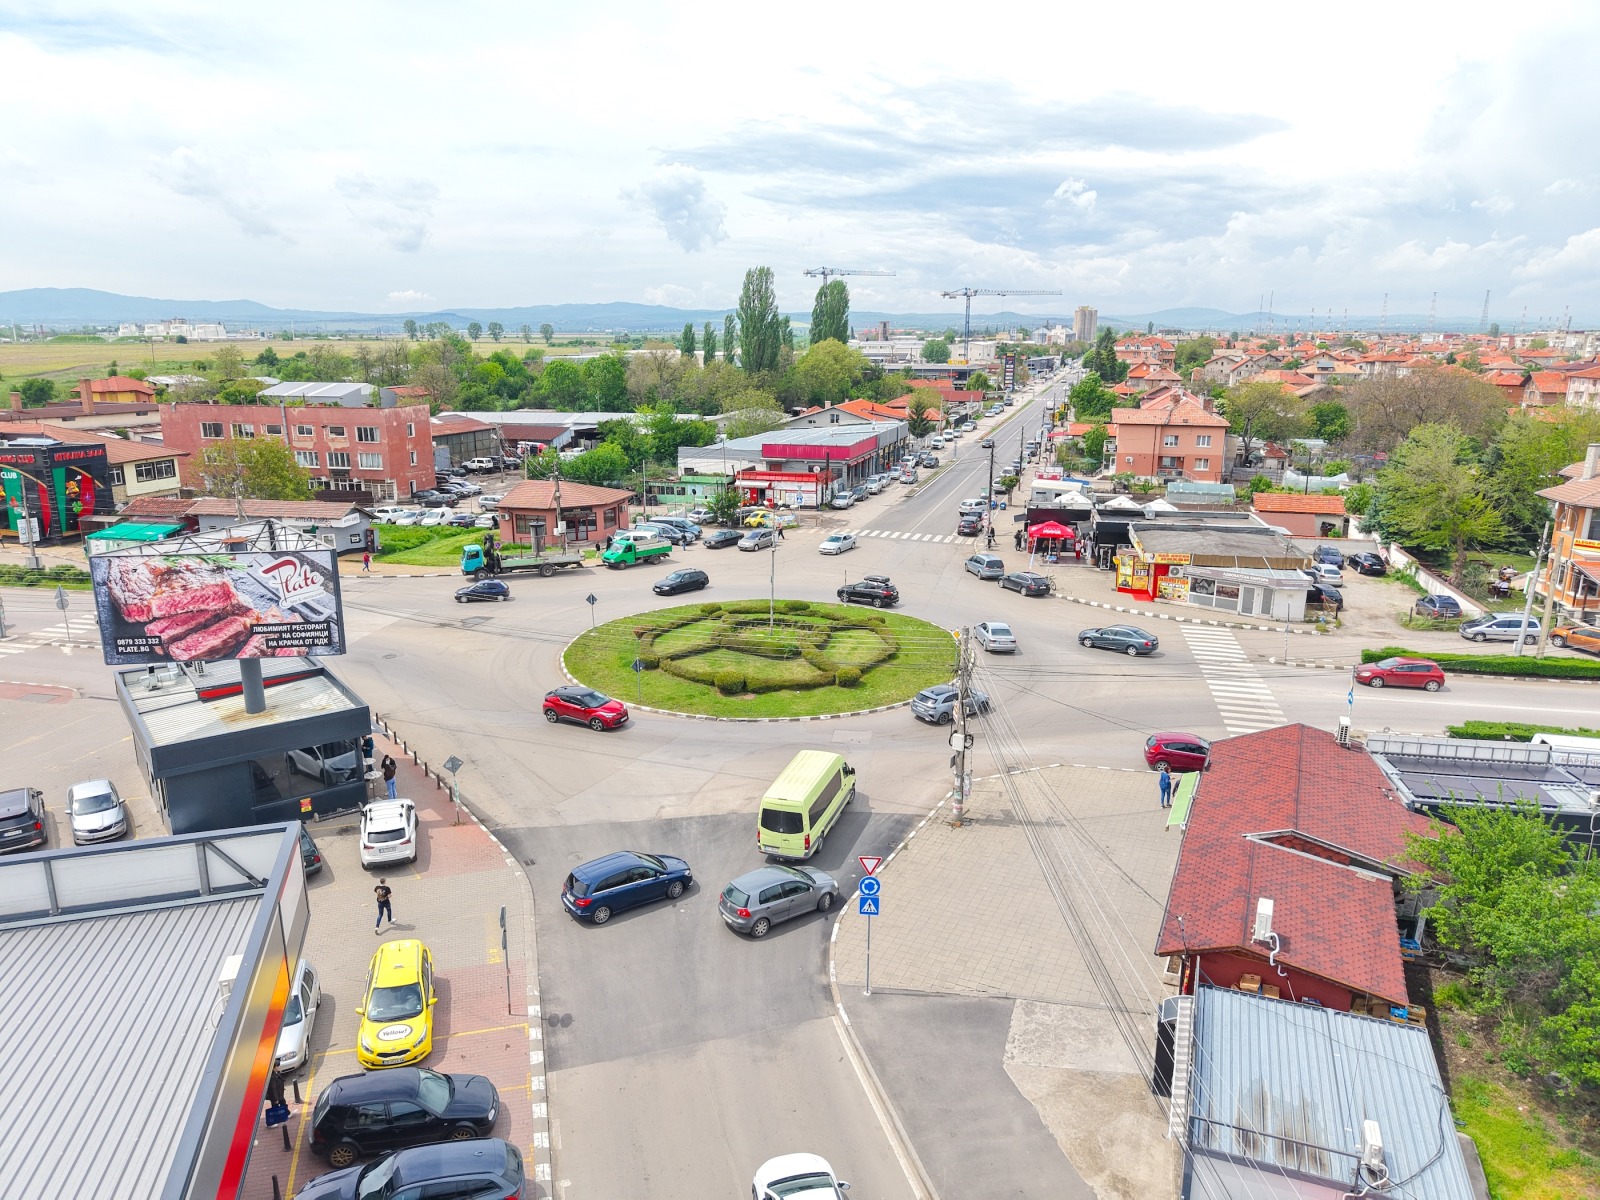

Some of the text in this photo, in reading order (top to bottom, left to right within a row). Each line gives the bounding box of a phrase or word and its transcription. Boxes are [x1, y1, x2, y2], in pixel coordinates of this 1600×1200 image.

[1, 471, 17, 479] CLUB
[262, 559, 319, 604] Plate
[253, 623, 328, 633] ЛЮБИМИЯТ РЕСТОРАНТ
[382, 1028, 408, 1036] Yellow!
